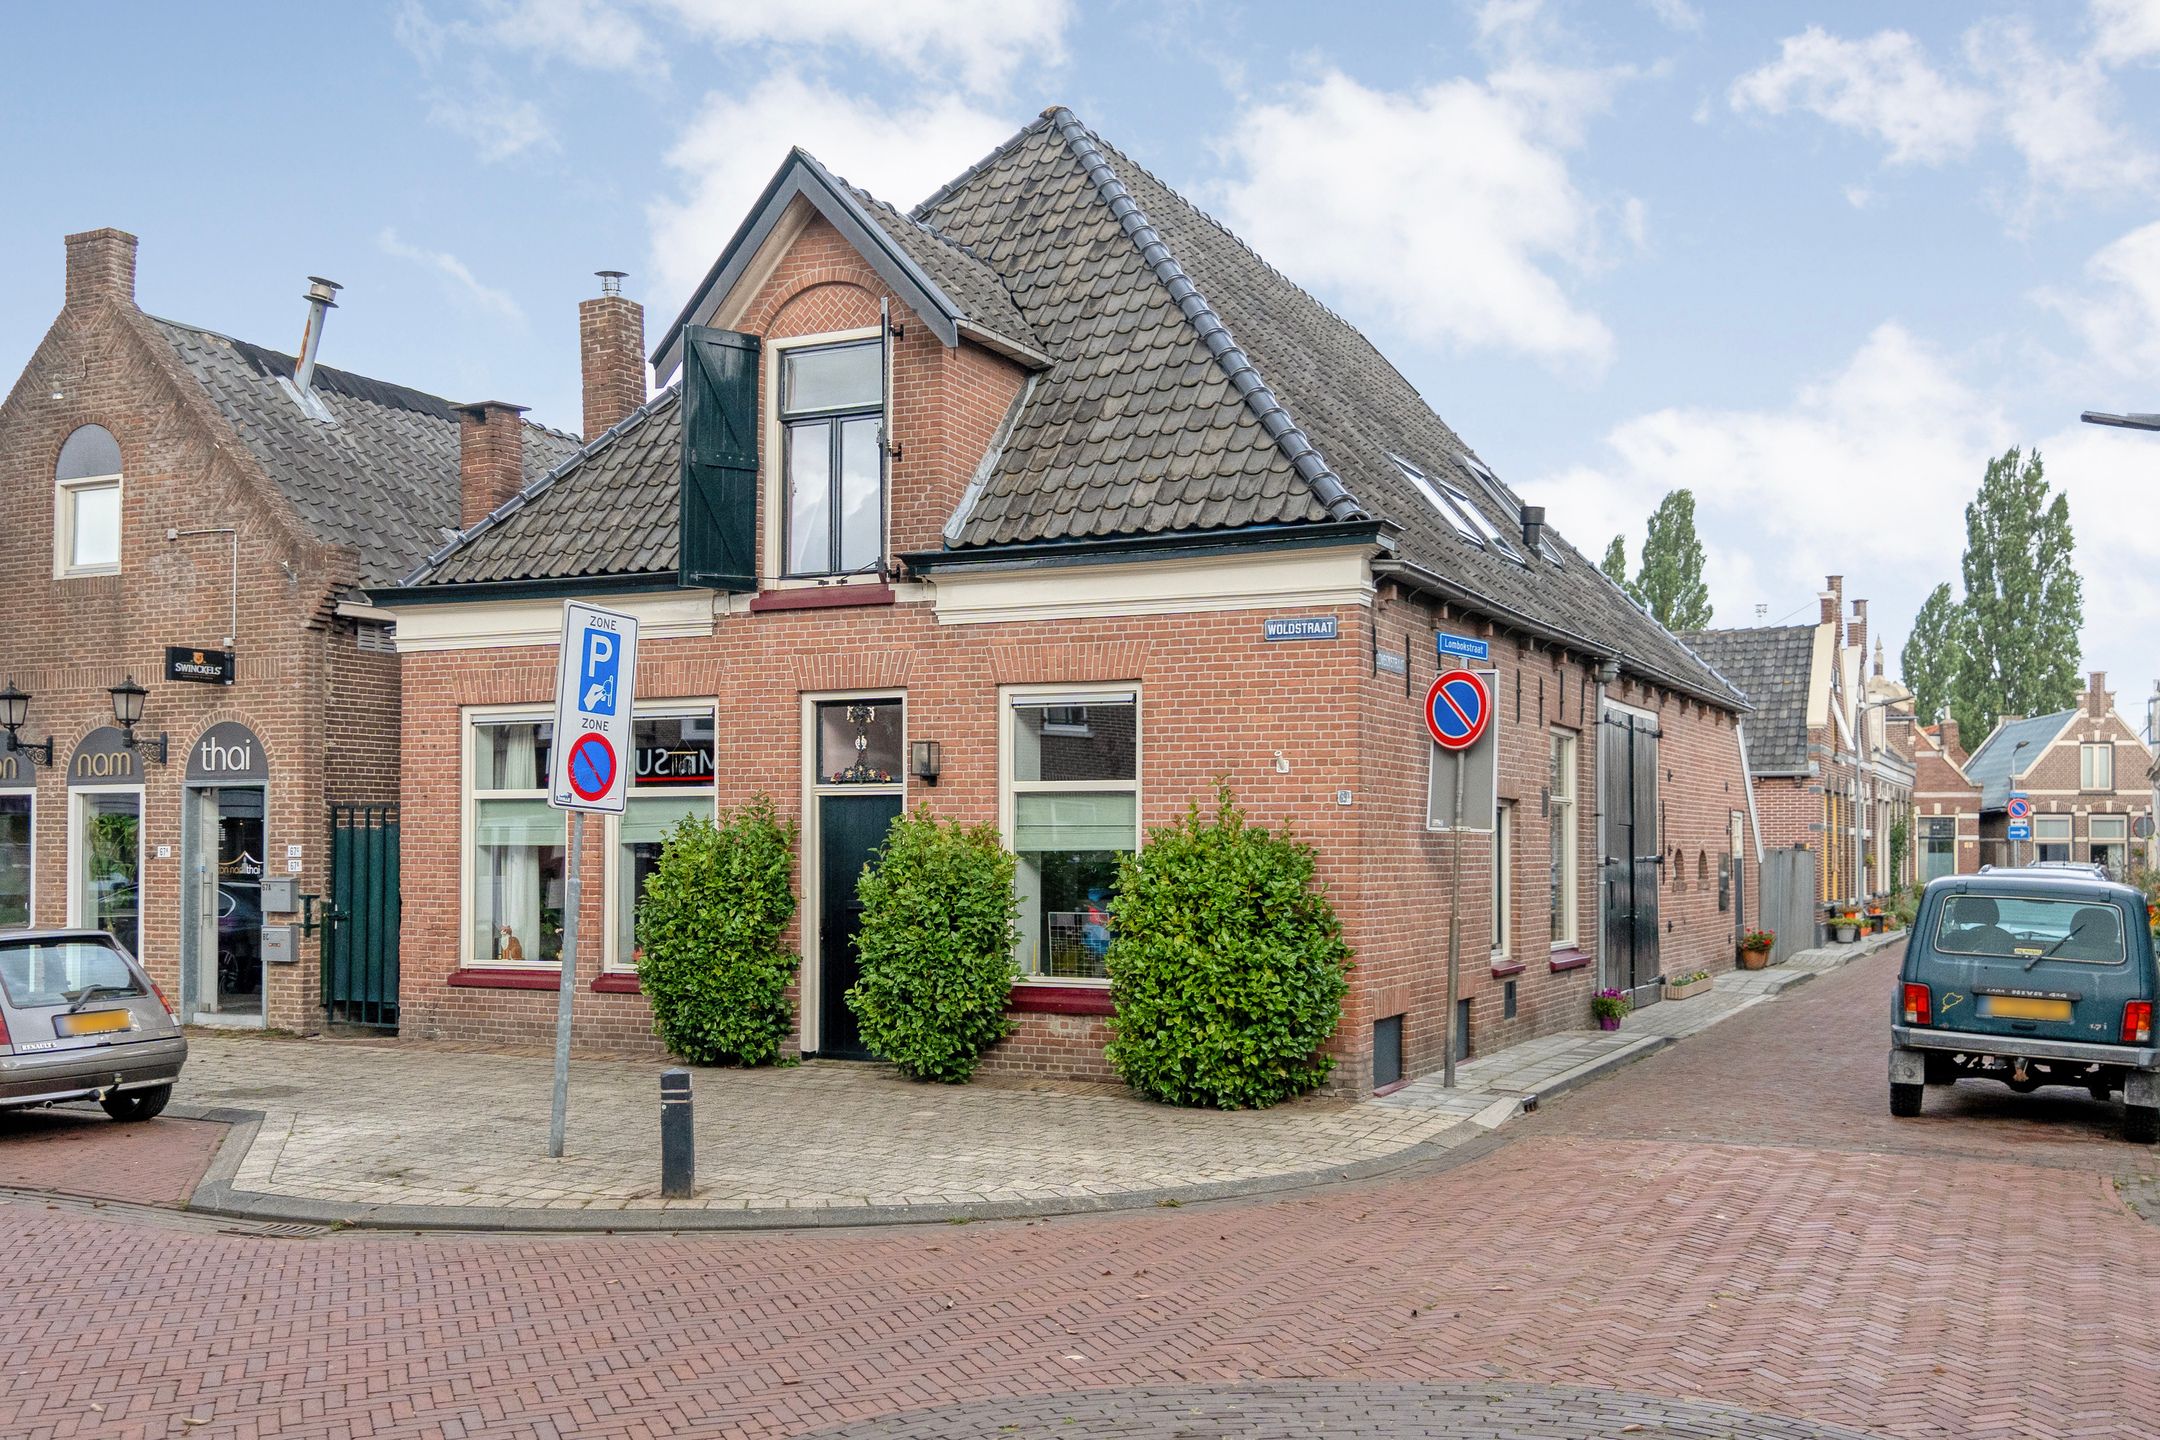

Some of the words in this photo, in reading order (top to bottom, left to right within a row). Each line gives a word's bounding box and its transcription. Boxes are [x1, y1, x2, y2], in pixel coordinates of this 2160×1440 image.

[590, 615, 617, 631] ZONE
[1267, 621, 1334, 635] WOLDSTRAAT
[1444, 638, 1484, 654] Lombokstraat
[588, 633, 613, 677] P
[581, 717, 609, 732] ZONE
[201, 736, 251, 771] thai
[77, 752, 132, 777] nam
[246, 864, 261, 874] thai
[21, 1042, 53, 1051] RENAULT
